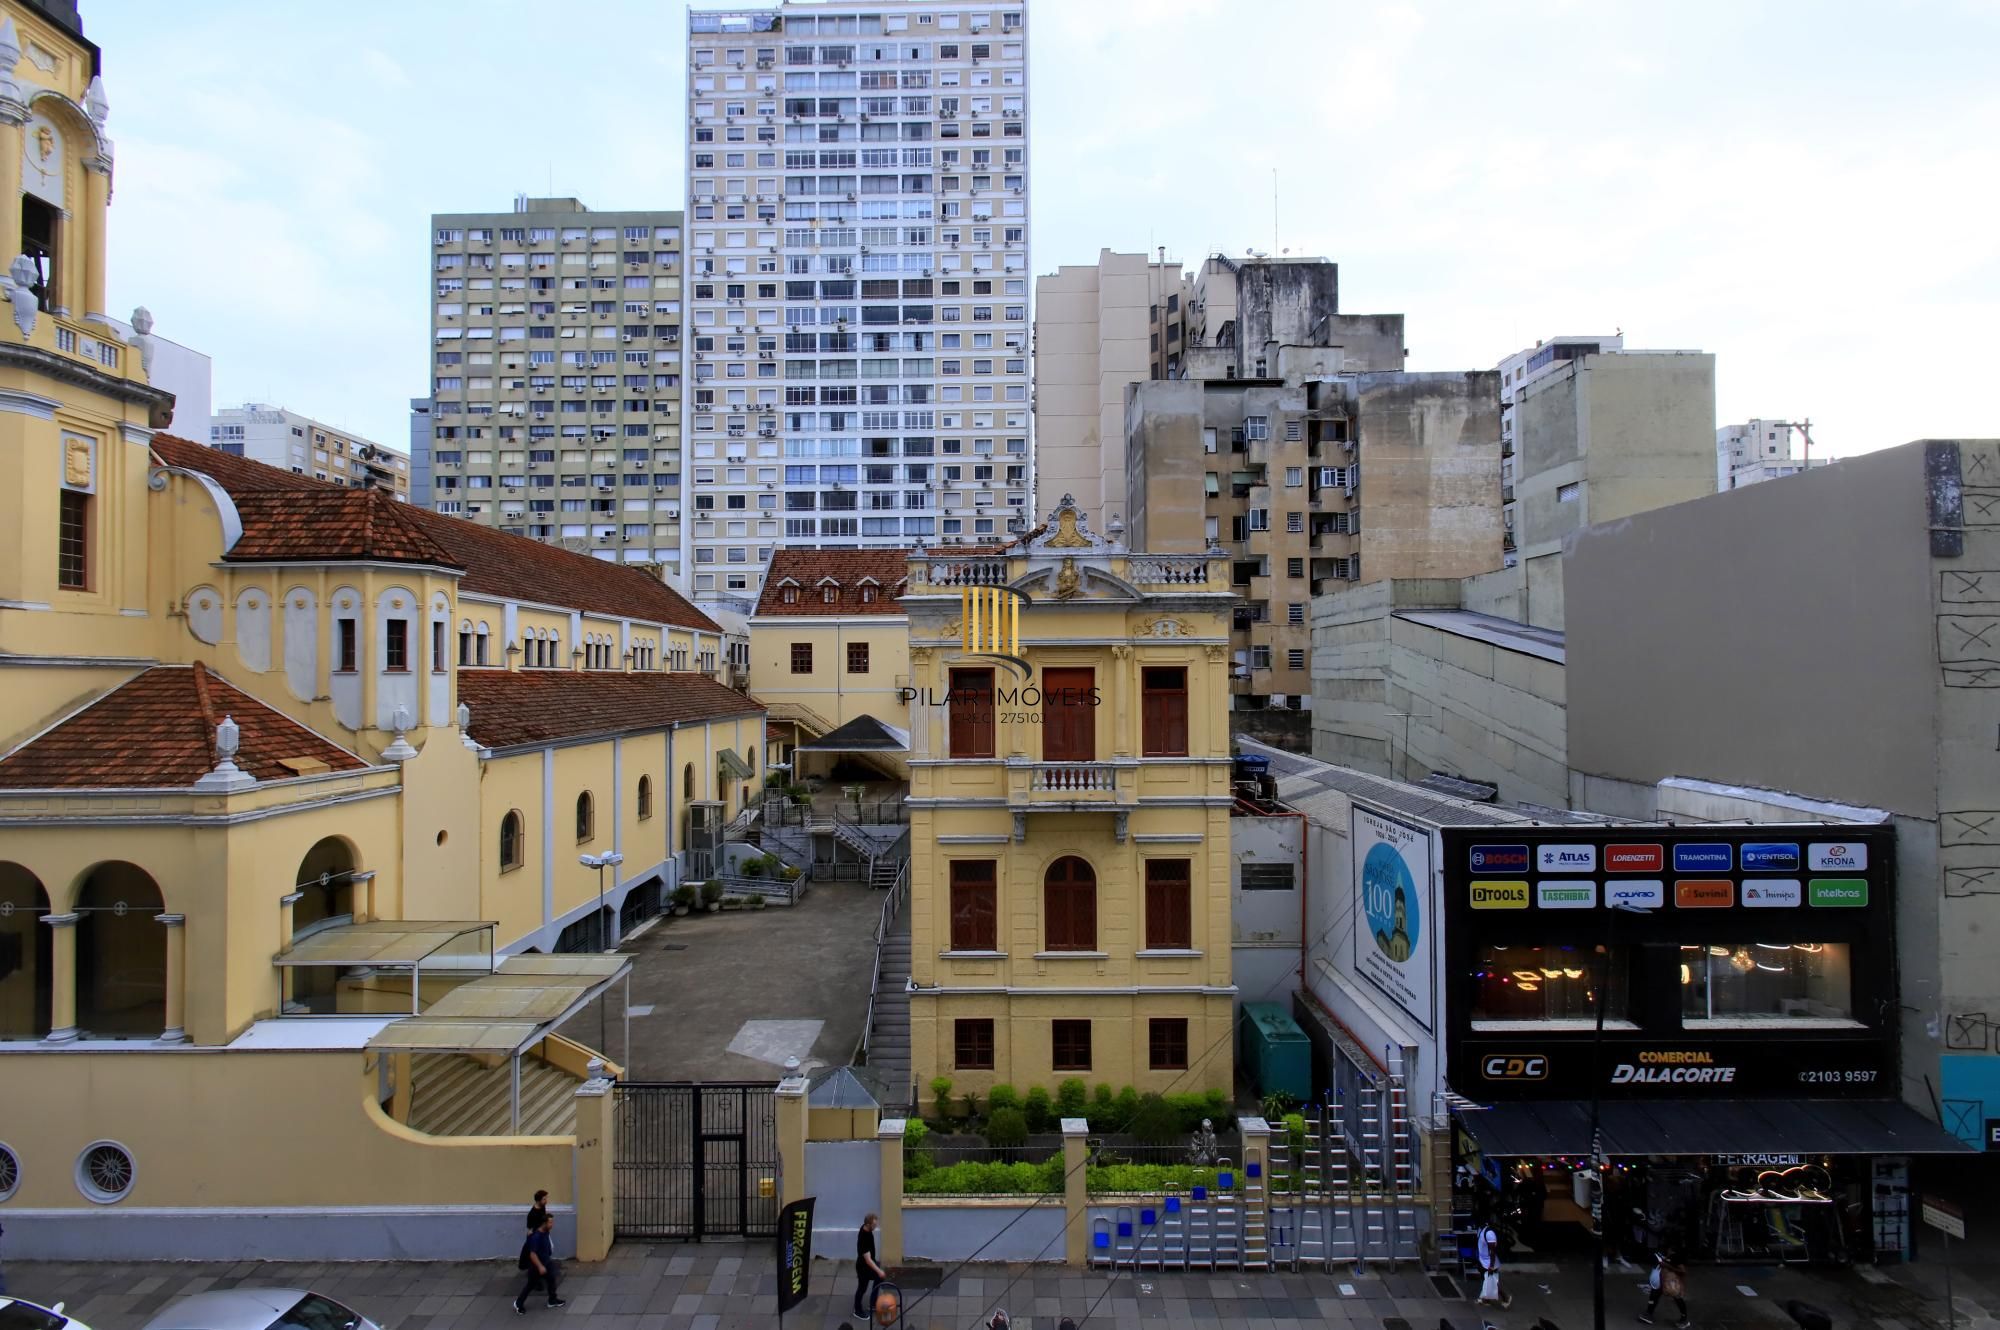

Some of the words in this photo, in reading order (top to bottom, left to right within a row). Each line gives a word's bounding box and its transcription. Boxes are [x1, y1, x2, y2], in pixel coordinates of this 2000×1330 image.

[1485, 853, 1528, 865] BOSCH
[1558, 851, 1590, 862] ATLAS
[1612, 854, 1656, 862] LORENZETTI
[1820, 857, 1855, 865] KRONA
[1365, 879, 1392, 919] 100
[1540, 888, 1591, 901] TASCHIBRA
[1693, 888, 1728, 898] Suvinil
[1816, 888, 1861, 898] intelbras
[1638, 1051, 1713, 1064] COMERCIAL
[1485, 1058, 1544, 1076] CDC
[1610, 1064, 1736, 1084] DALACORTE
[1807, 1070, 1842, 1083] 2103
[1844, 1069, 1878, 1082] 9597
[791, 1211, 808, 1294] FERRAGEM
